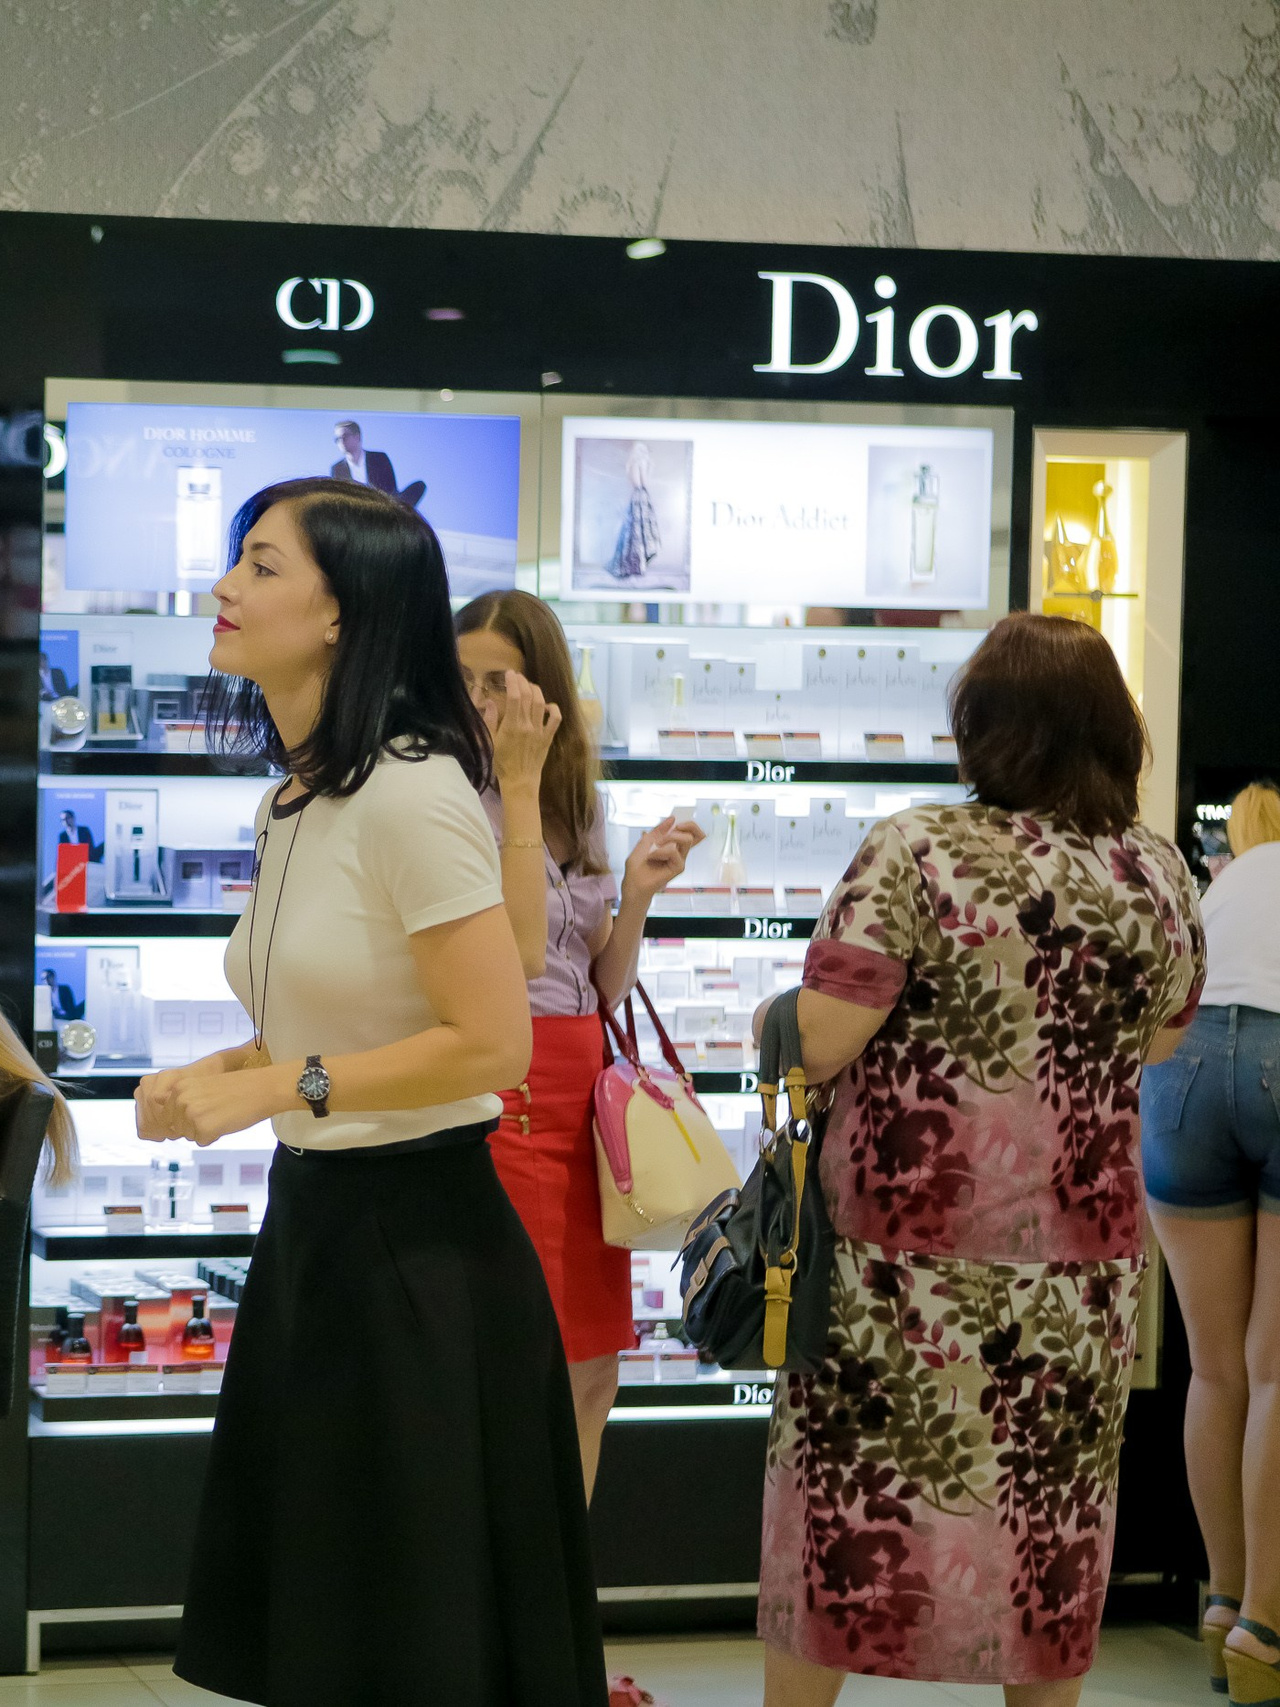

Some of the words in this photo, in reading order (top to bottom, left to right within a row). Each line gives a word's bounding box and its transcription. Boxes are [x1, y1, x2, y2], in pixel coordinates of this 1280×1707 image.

[752, 270, 1039, 381] Dior
[143, 427, 186, 441] DIOR
[190, 428, 256, 443] HOMME
[163, 446, 236, 459] COLOGNE
[710, 499, 765, 528] Dior
[747, 760, 795, 782] Dior
[744, 917, 793, 938] Dior
[733, 1384, 775, 1405] Dio
